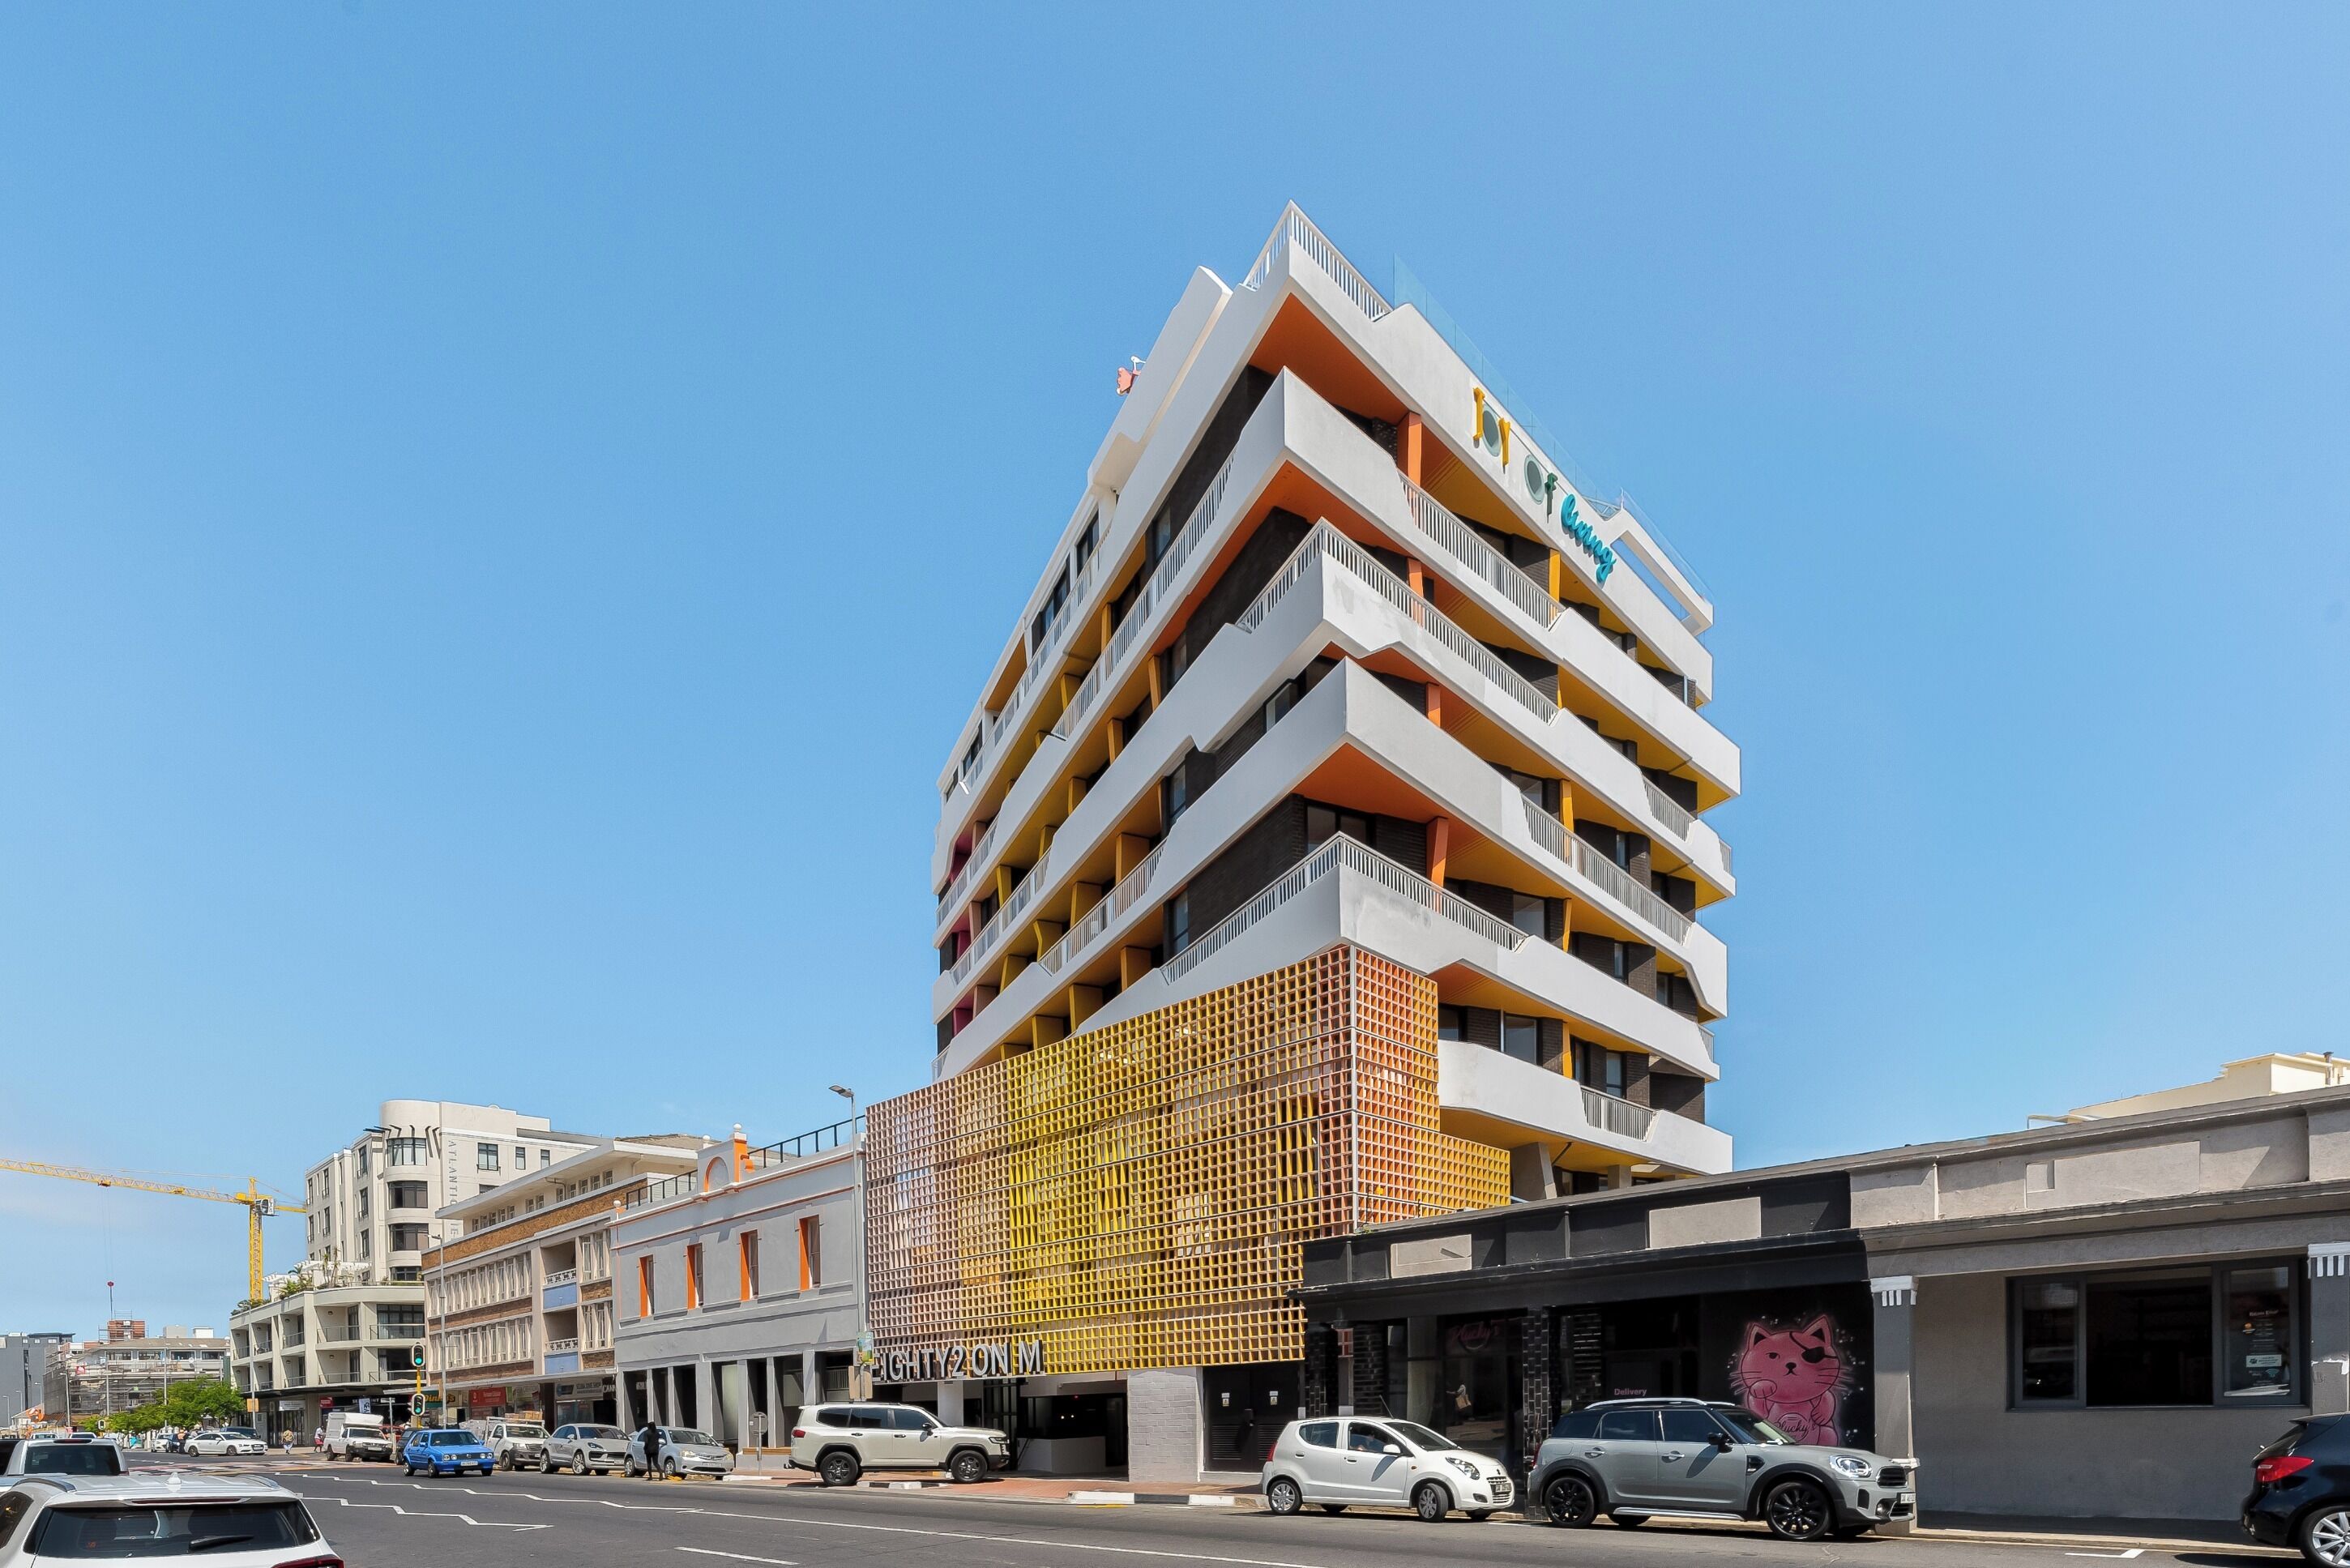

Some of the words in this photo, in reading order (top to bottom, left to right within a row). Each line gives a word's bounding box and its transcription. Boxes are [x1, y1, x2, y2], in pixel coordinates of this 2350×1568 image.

[1473, 387, 1510, 466] JOY
[448, 1140, 458, 1206] ATLANTIC
[972, 1342, 1011, 1377] ON
[1019, 1339, 1044, 1374] M
[1614, 1388, 1647, 1397] Delivery
